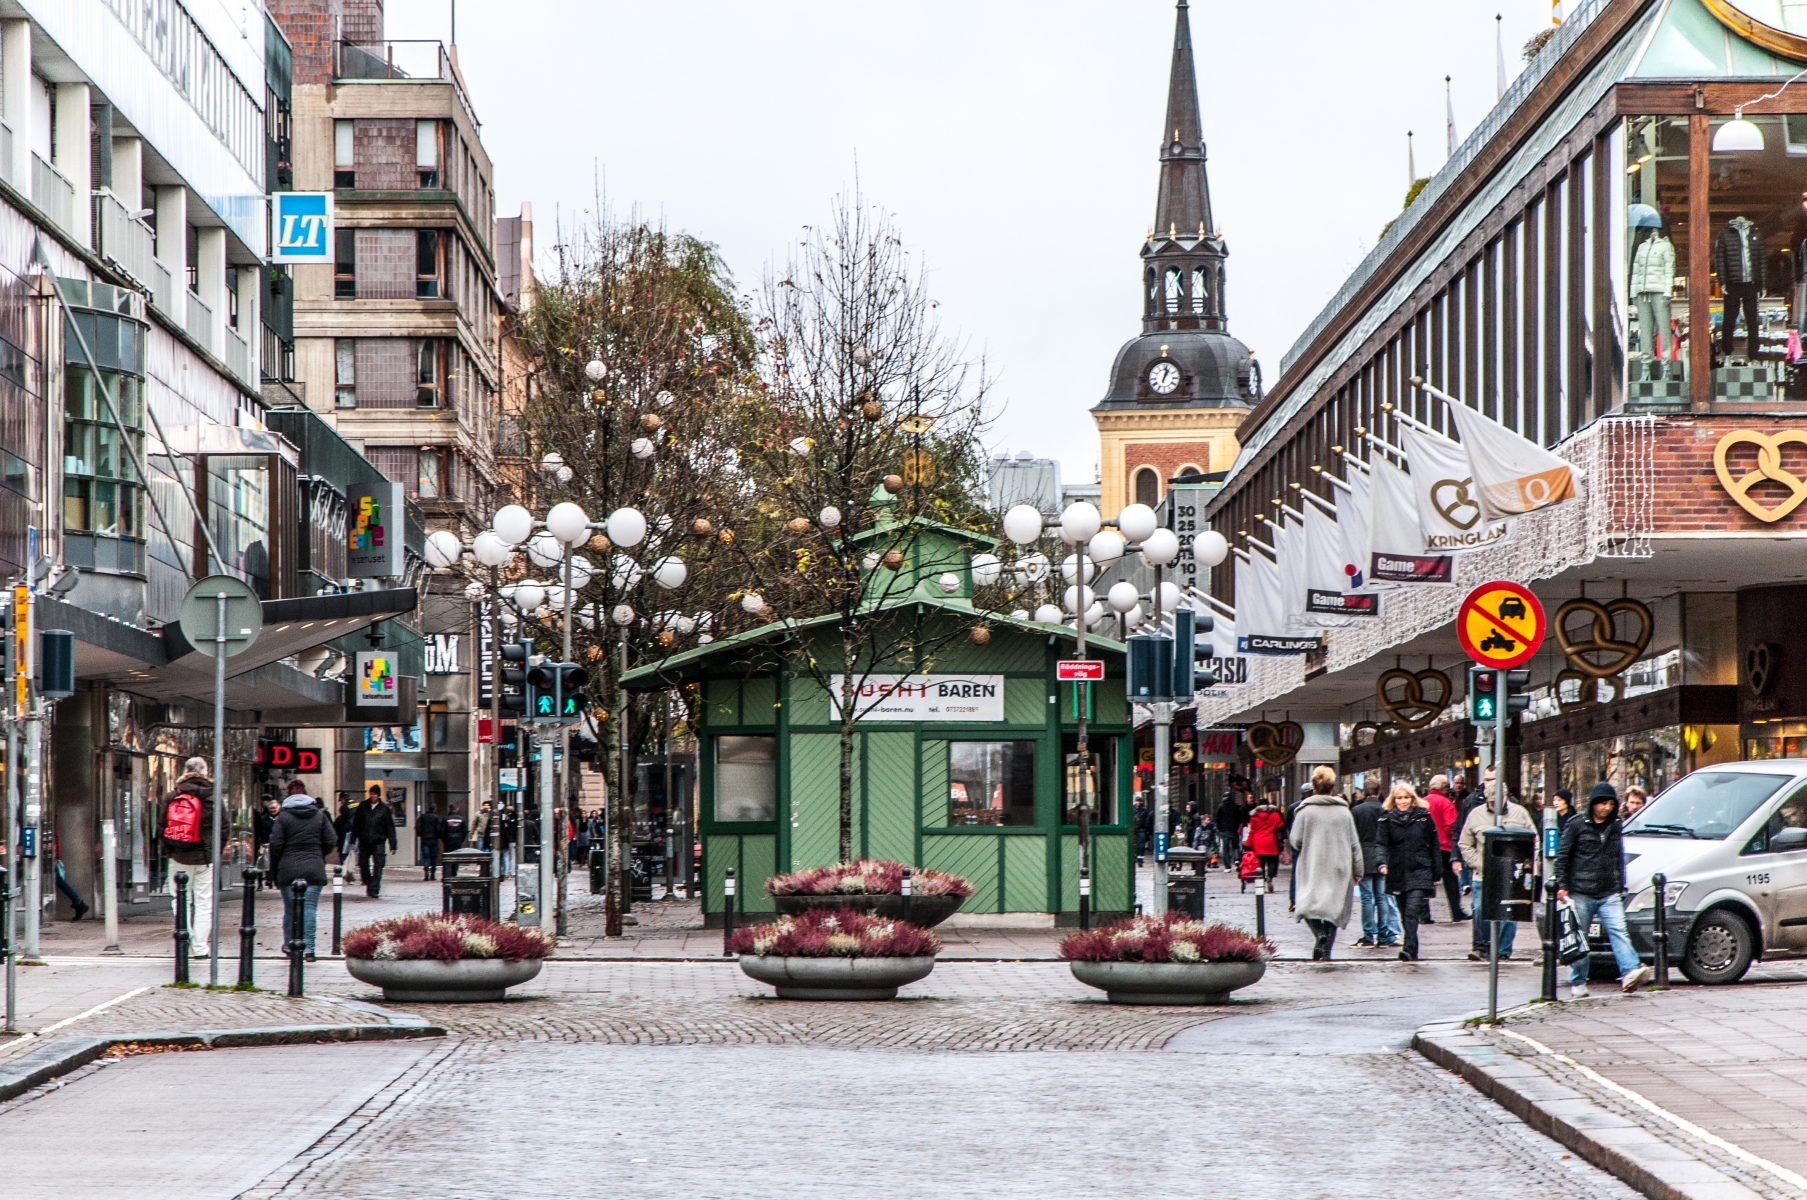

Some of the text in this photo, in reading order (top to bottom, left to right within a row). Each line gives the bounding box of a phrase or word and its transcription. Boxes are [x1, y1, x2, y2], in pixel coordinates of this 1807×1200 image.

[277, 214, 329, 248] LT
[1178, 505, 1196, 517] 30
[1178, 520, 1196, 532] 25
[1179, 534, 1195, 546] 20
[1428, 523, 1507, 548] KRINGLAN
[1181, 563, 1197, 575] 10
[1312, 593, 1371, 608] GameStop
[1251, 639, 1318, 650] CARLINGS
[1073, 670, 1088, 678] väg
[840, 684, 995, 698] SUSHI BAREN
[1173, 742, 1195, 763] 3
[1746, 873, 1771, 885] 1195
